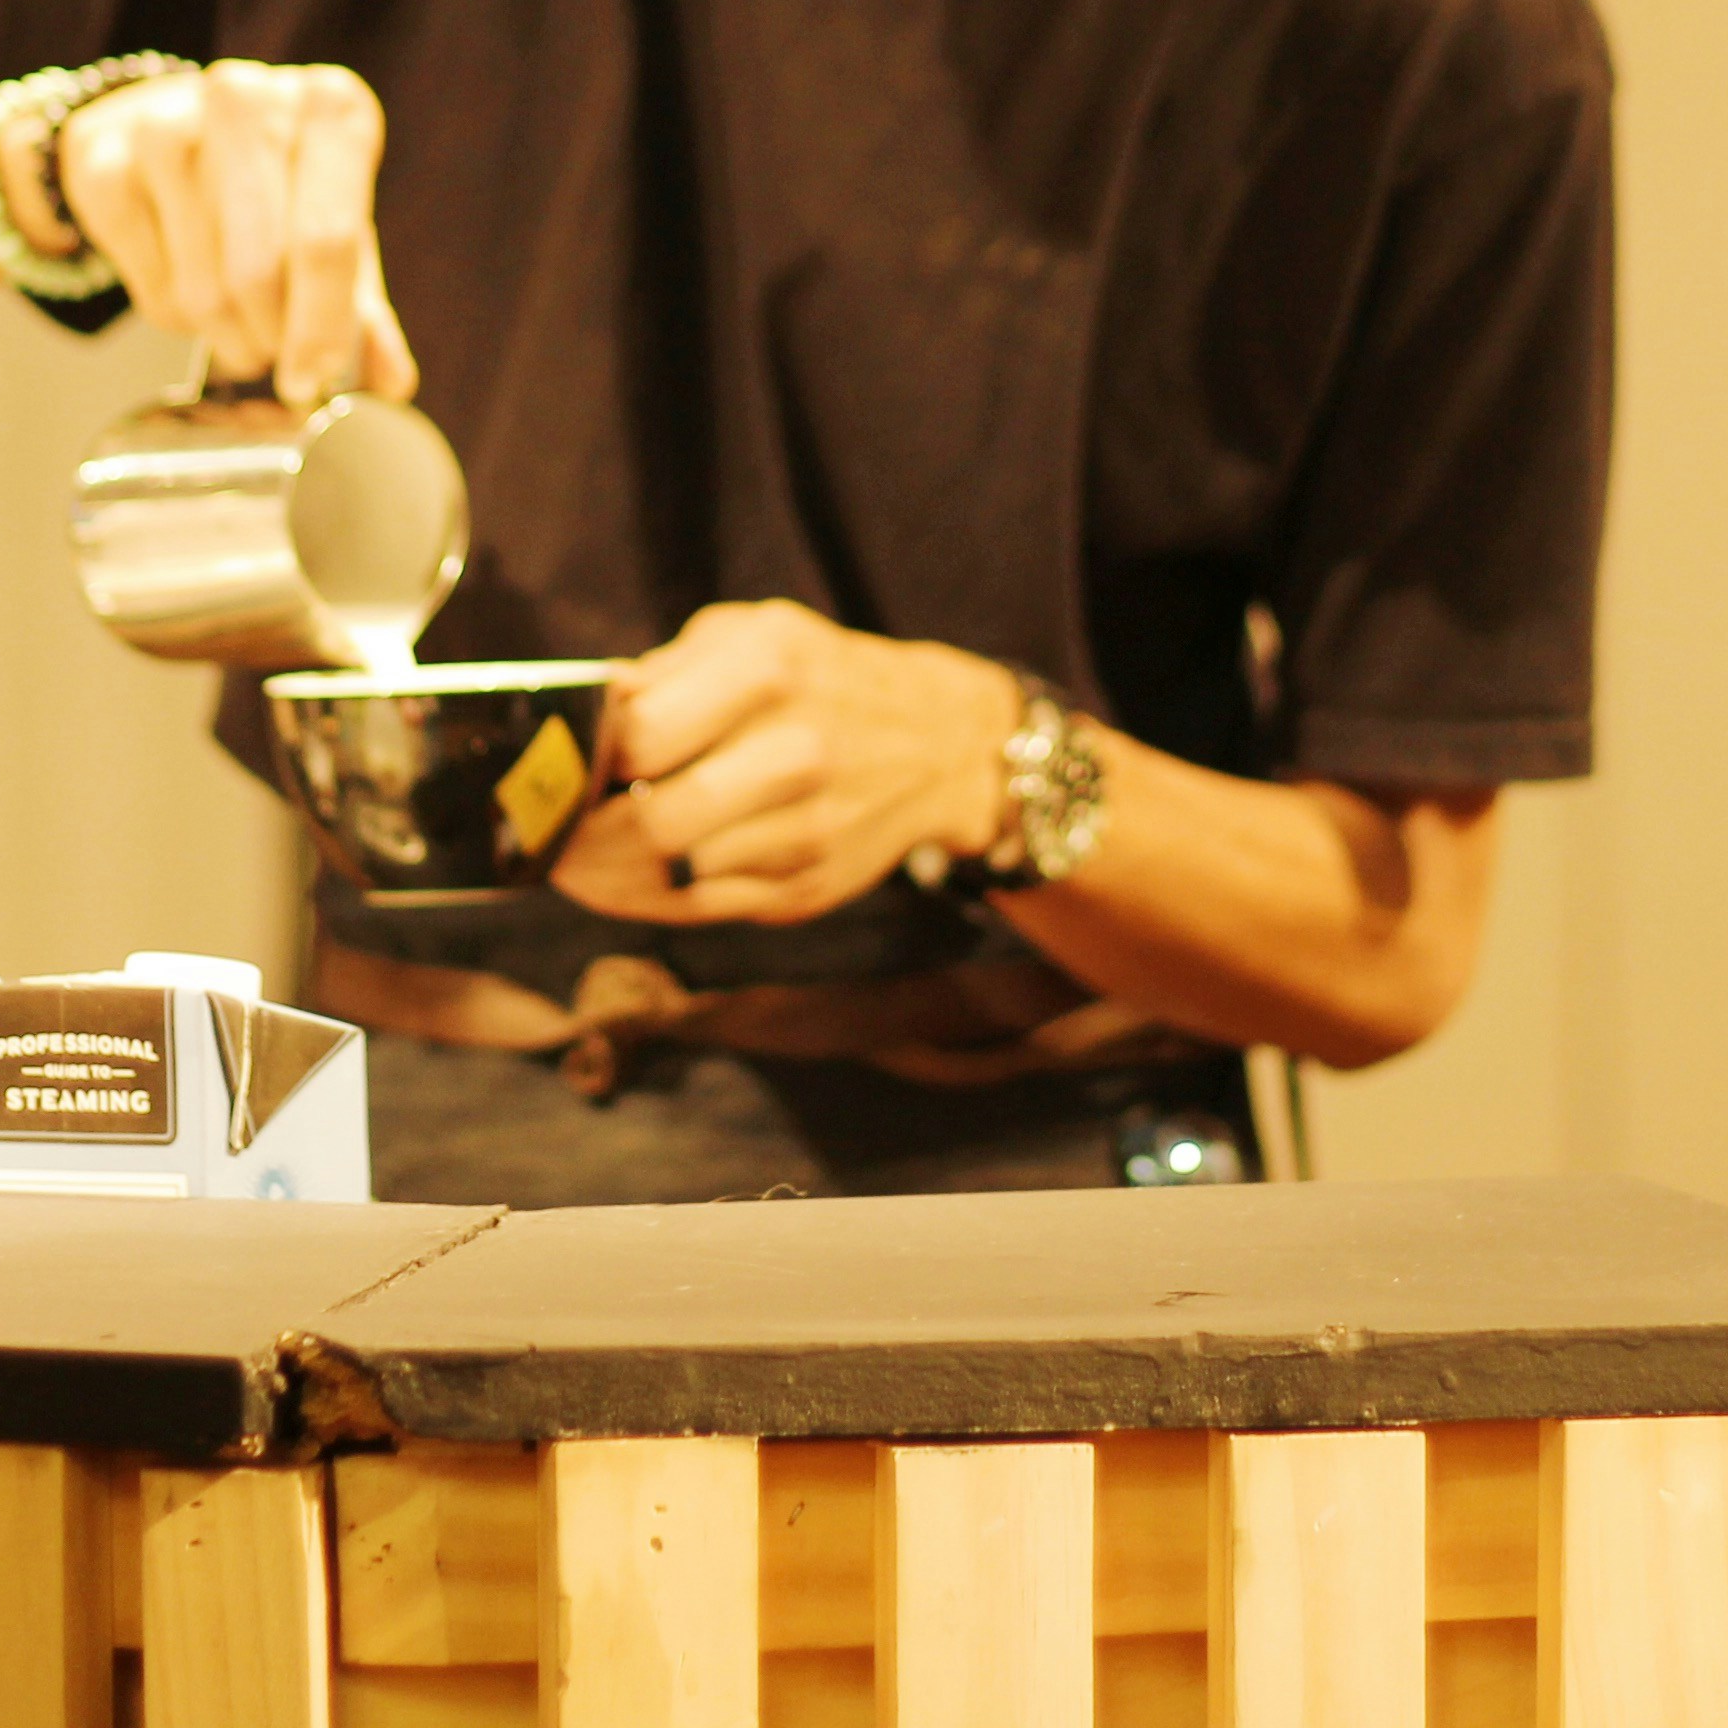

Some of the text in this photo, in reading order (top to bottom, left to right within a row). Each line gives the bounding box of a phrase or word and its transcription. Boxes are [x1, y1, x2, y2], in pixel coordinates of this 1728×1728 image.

[43, 1063, 112, 1080] GUIDE TO
[6, 1087, 151, 1114] STEAMING
